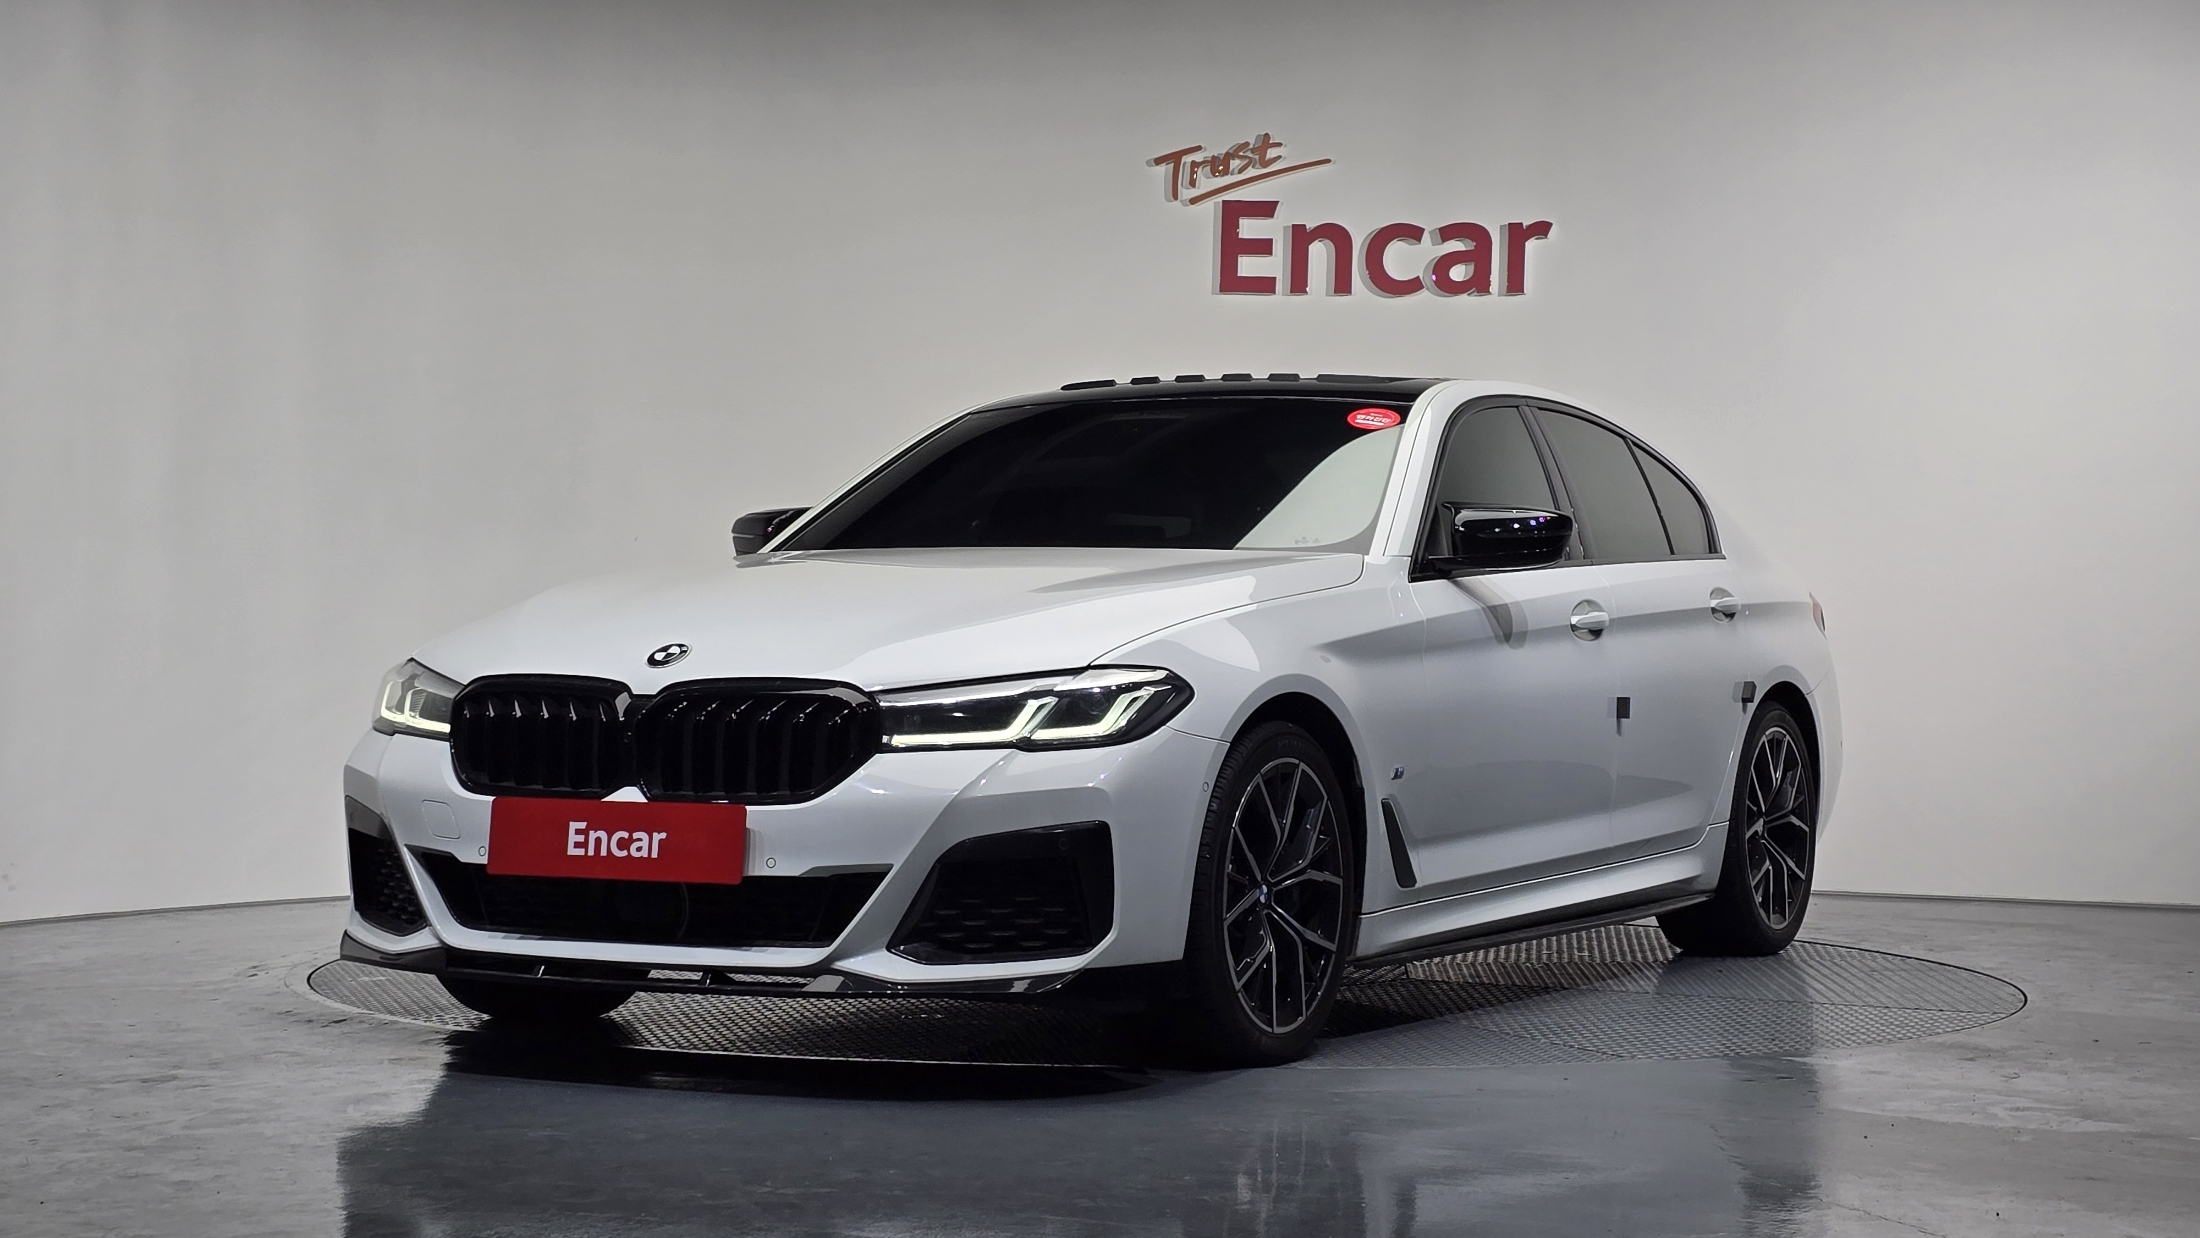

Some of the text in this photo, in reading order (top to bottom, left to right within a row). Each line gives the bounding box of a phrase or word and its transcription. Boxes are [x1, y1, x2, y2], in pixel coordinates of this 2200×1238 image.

[1152, 132, 1284, 201] Trust
[1216, 199, 1554, 297] Encar
[566, 820, 668, 859] Encar
